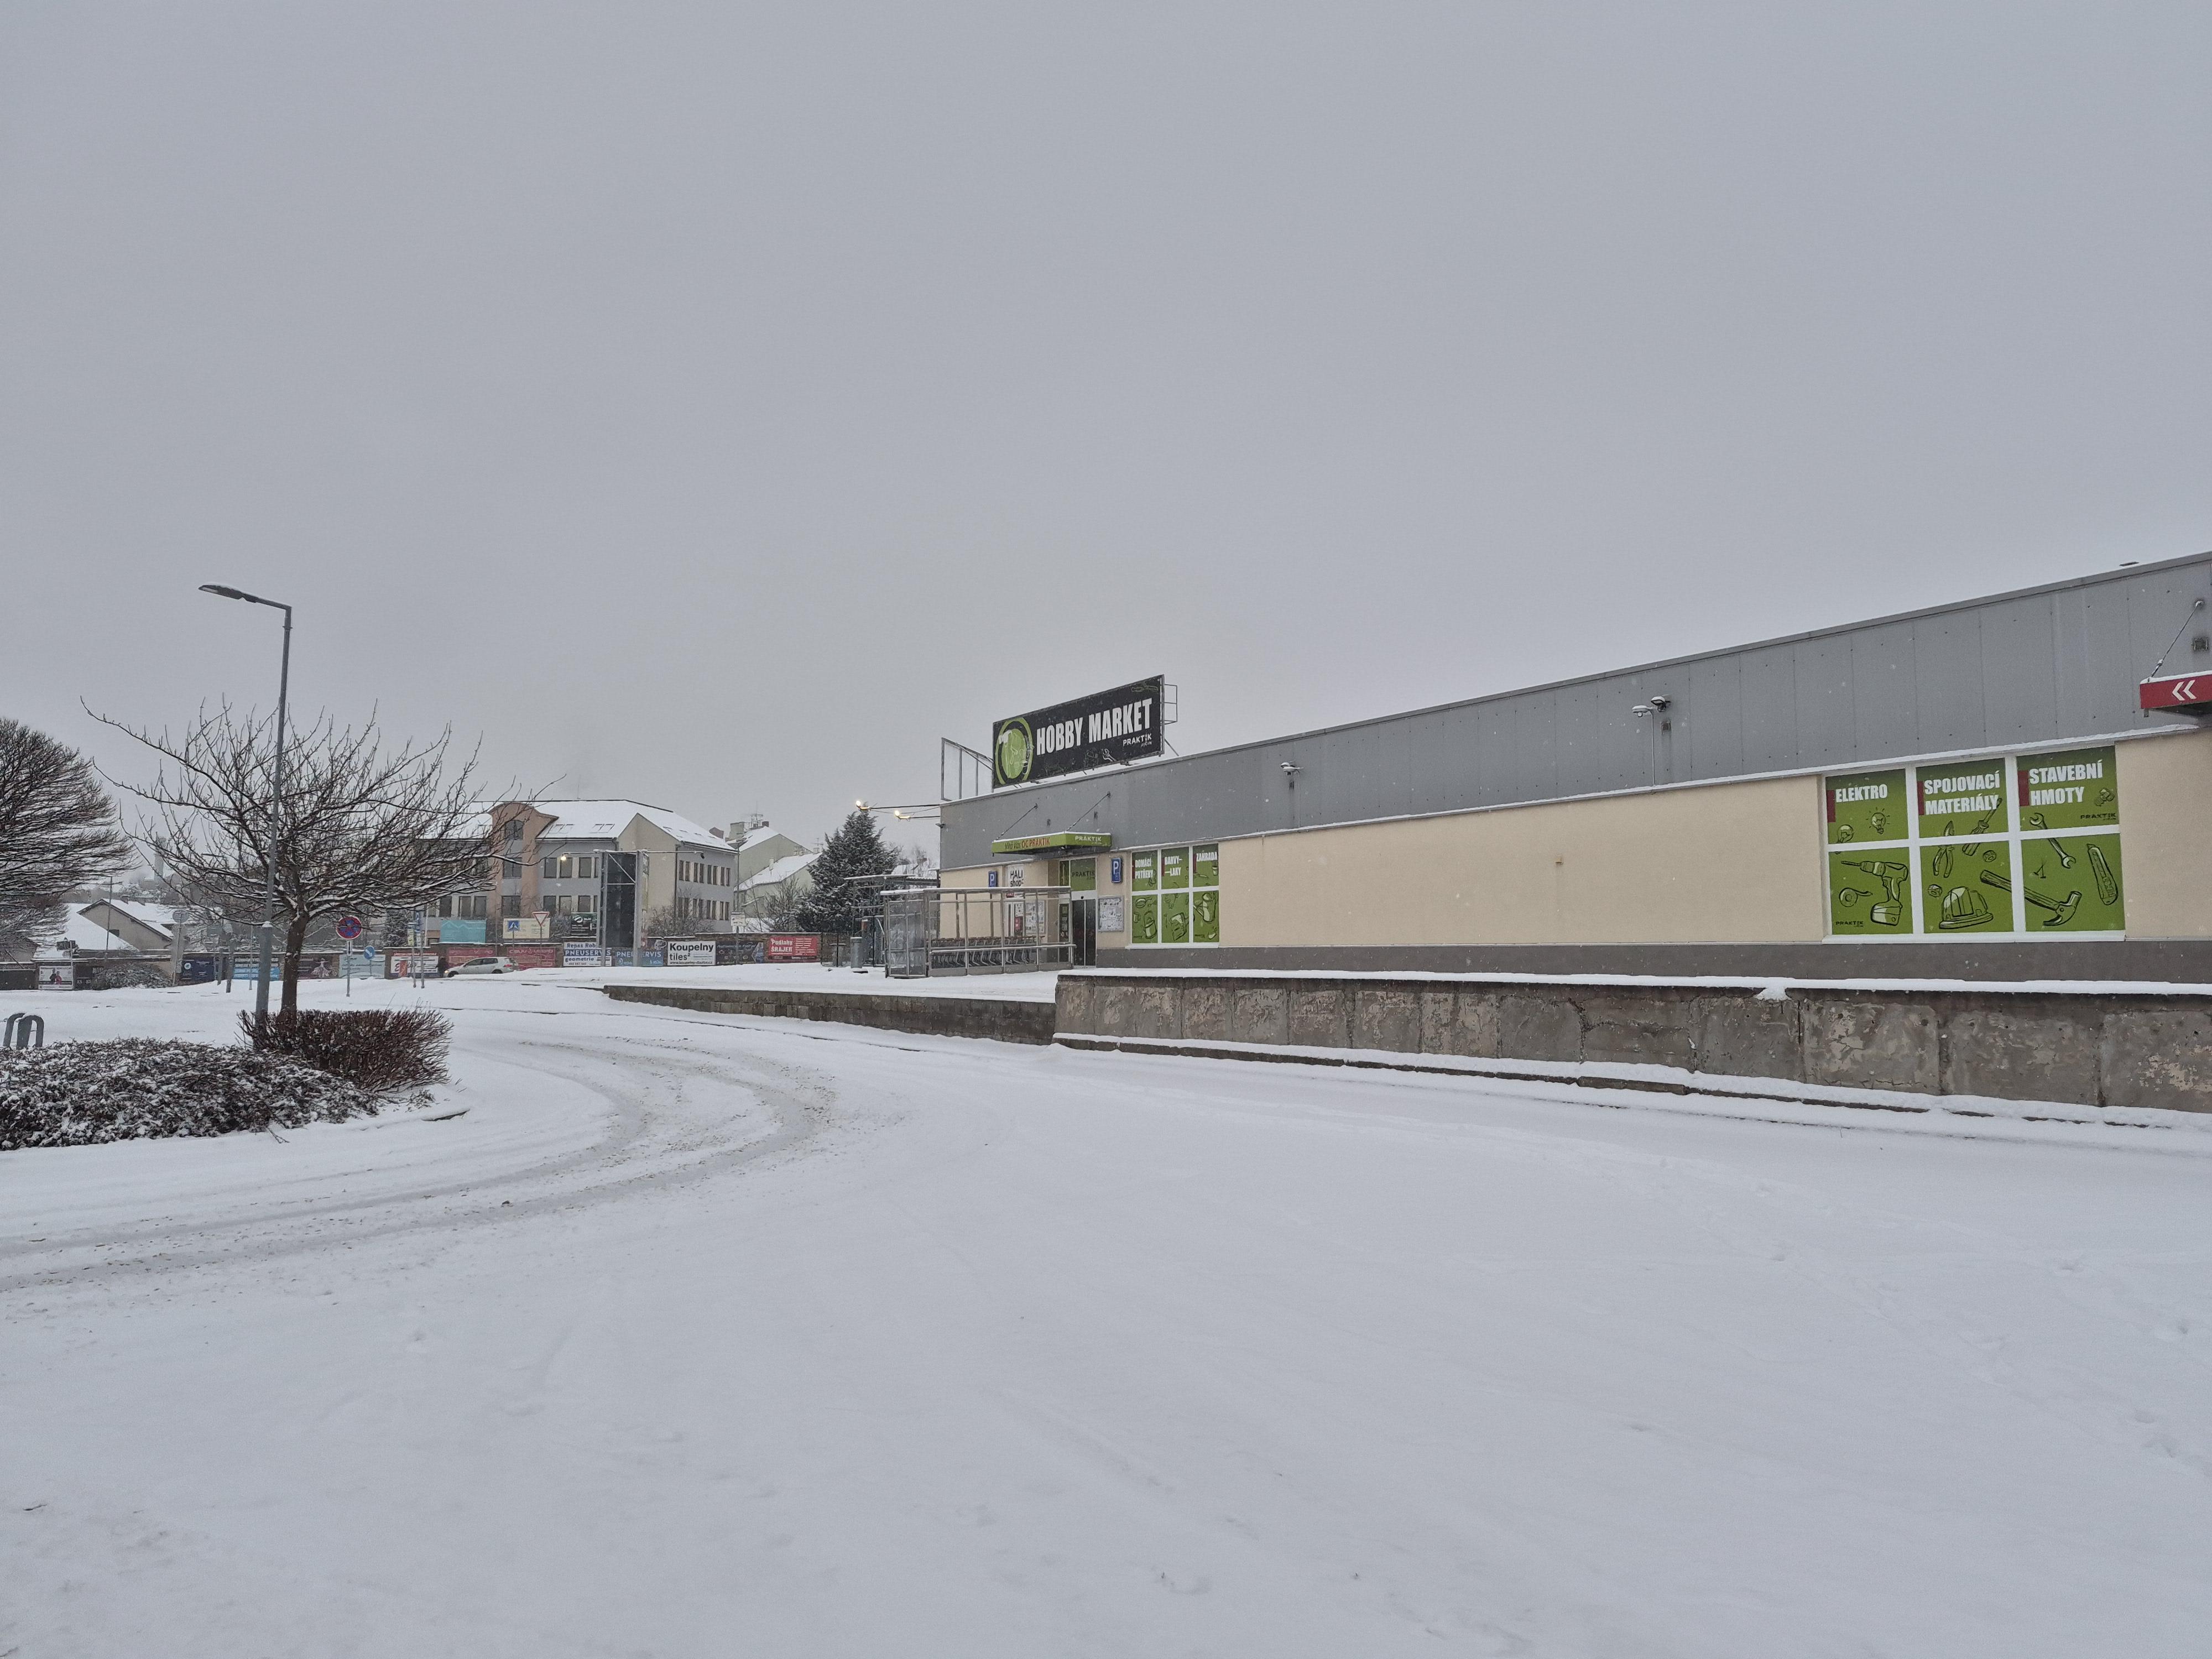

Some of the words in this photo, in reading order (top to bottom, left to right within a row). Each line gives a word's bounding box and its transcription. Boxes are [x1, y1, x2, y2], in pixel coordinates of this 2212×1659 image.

[1036, 717, 1083, 755] HOBBY
[1088, 698, 1152, 743] MARKET
[1123, 733, 1151, 747] PRAKTIK
[2029, 760, 2103, 784] STAVEBNÍ
[1924, 770, 2000, 795] SPOJOVACÍ
[1836, 784, 1888, 803] ELEKTRO
[2030, 786, 2084, 806] HMOTY
[1924, 793, 2000, 816] MATERIÁLY
[1029, 837, 1050, 847] PRAKTIK
[1196, 852, 1218, 862] ZAHRADA
[1010, 869, 1023, 879] HALI
[1113, 860, 1119, 875] P
[670, 943, 714, 952] Koupelny
